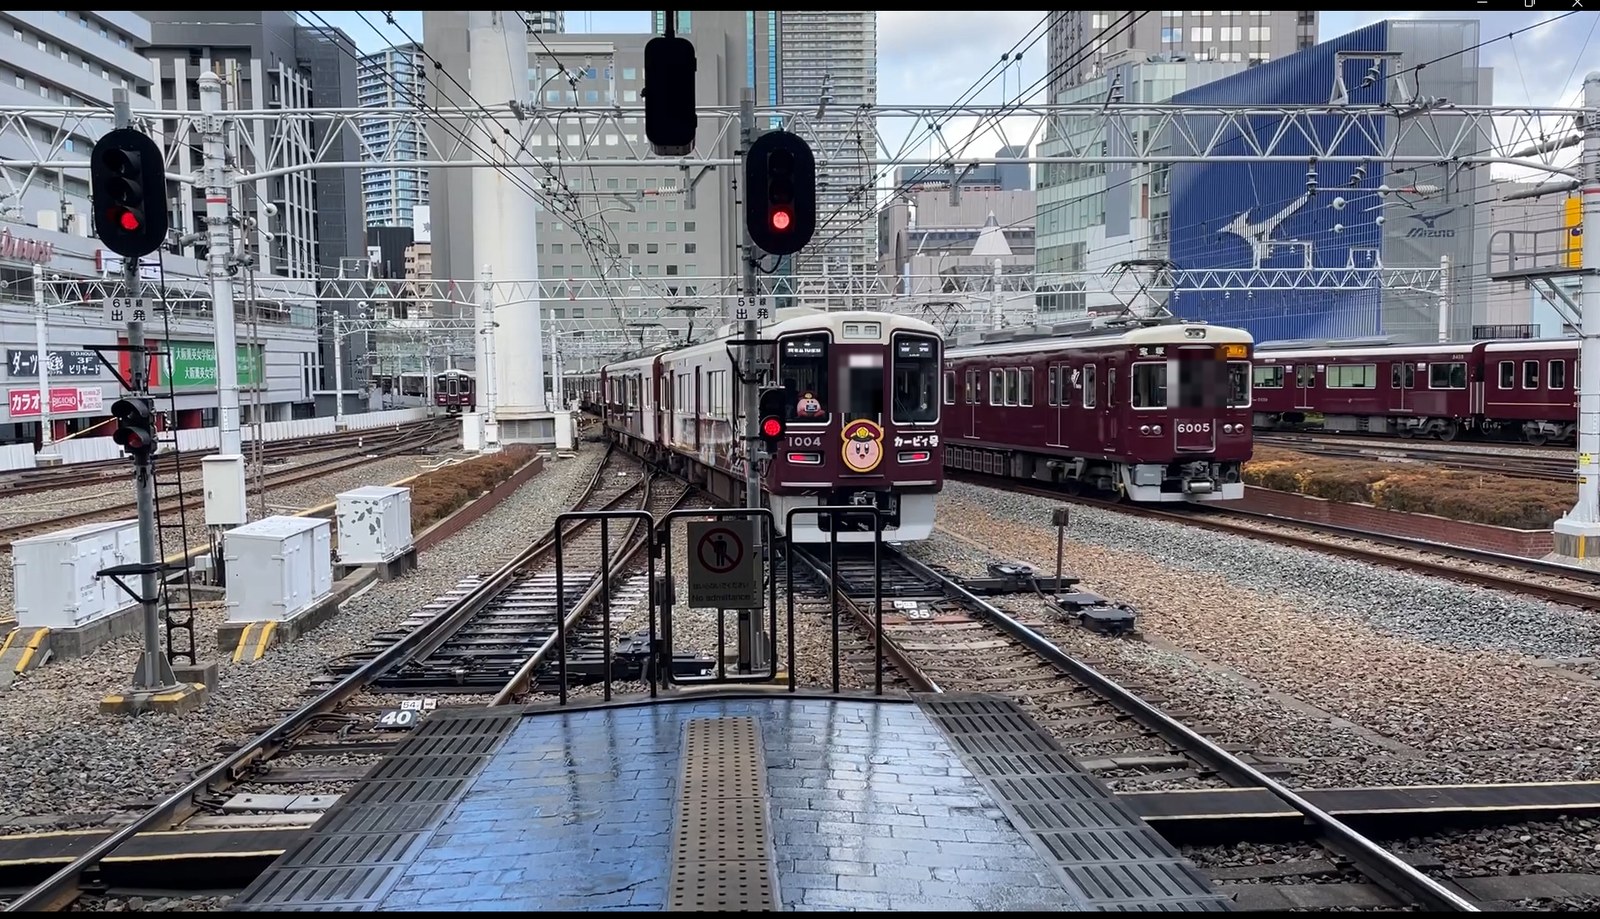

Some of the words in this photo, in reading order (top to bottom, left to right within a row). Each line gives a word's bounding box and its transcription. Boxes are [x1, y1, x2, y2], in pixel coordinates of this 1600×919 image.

[12, 351, 38, 375] ダーツ
[69, 364, 100, 375] ビリヤード
[12, 393, 40, 411] カラオ
[1177, 422, 1211, 433] 6005
[788, 436, 822, 447] 1004
[894, 434, 939, 447] カービィ号
[691, 594, 704, 602] No
[909, 609, 930, 619] 35
[381, 710, 412, 725] 40
